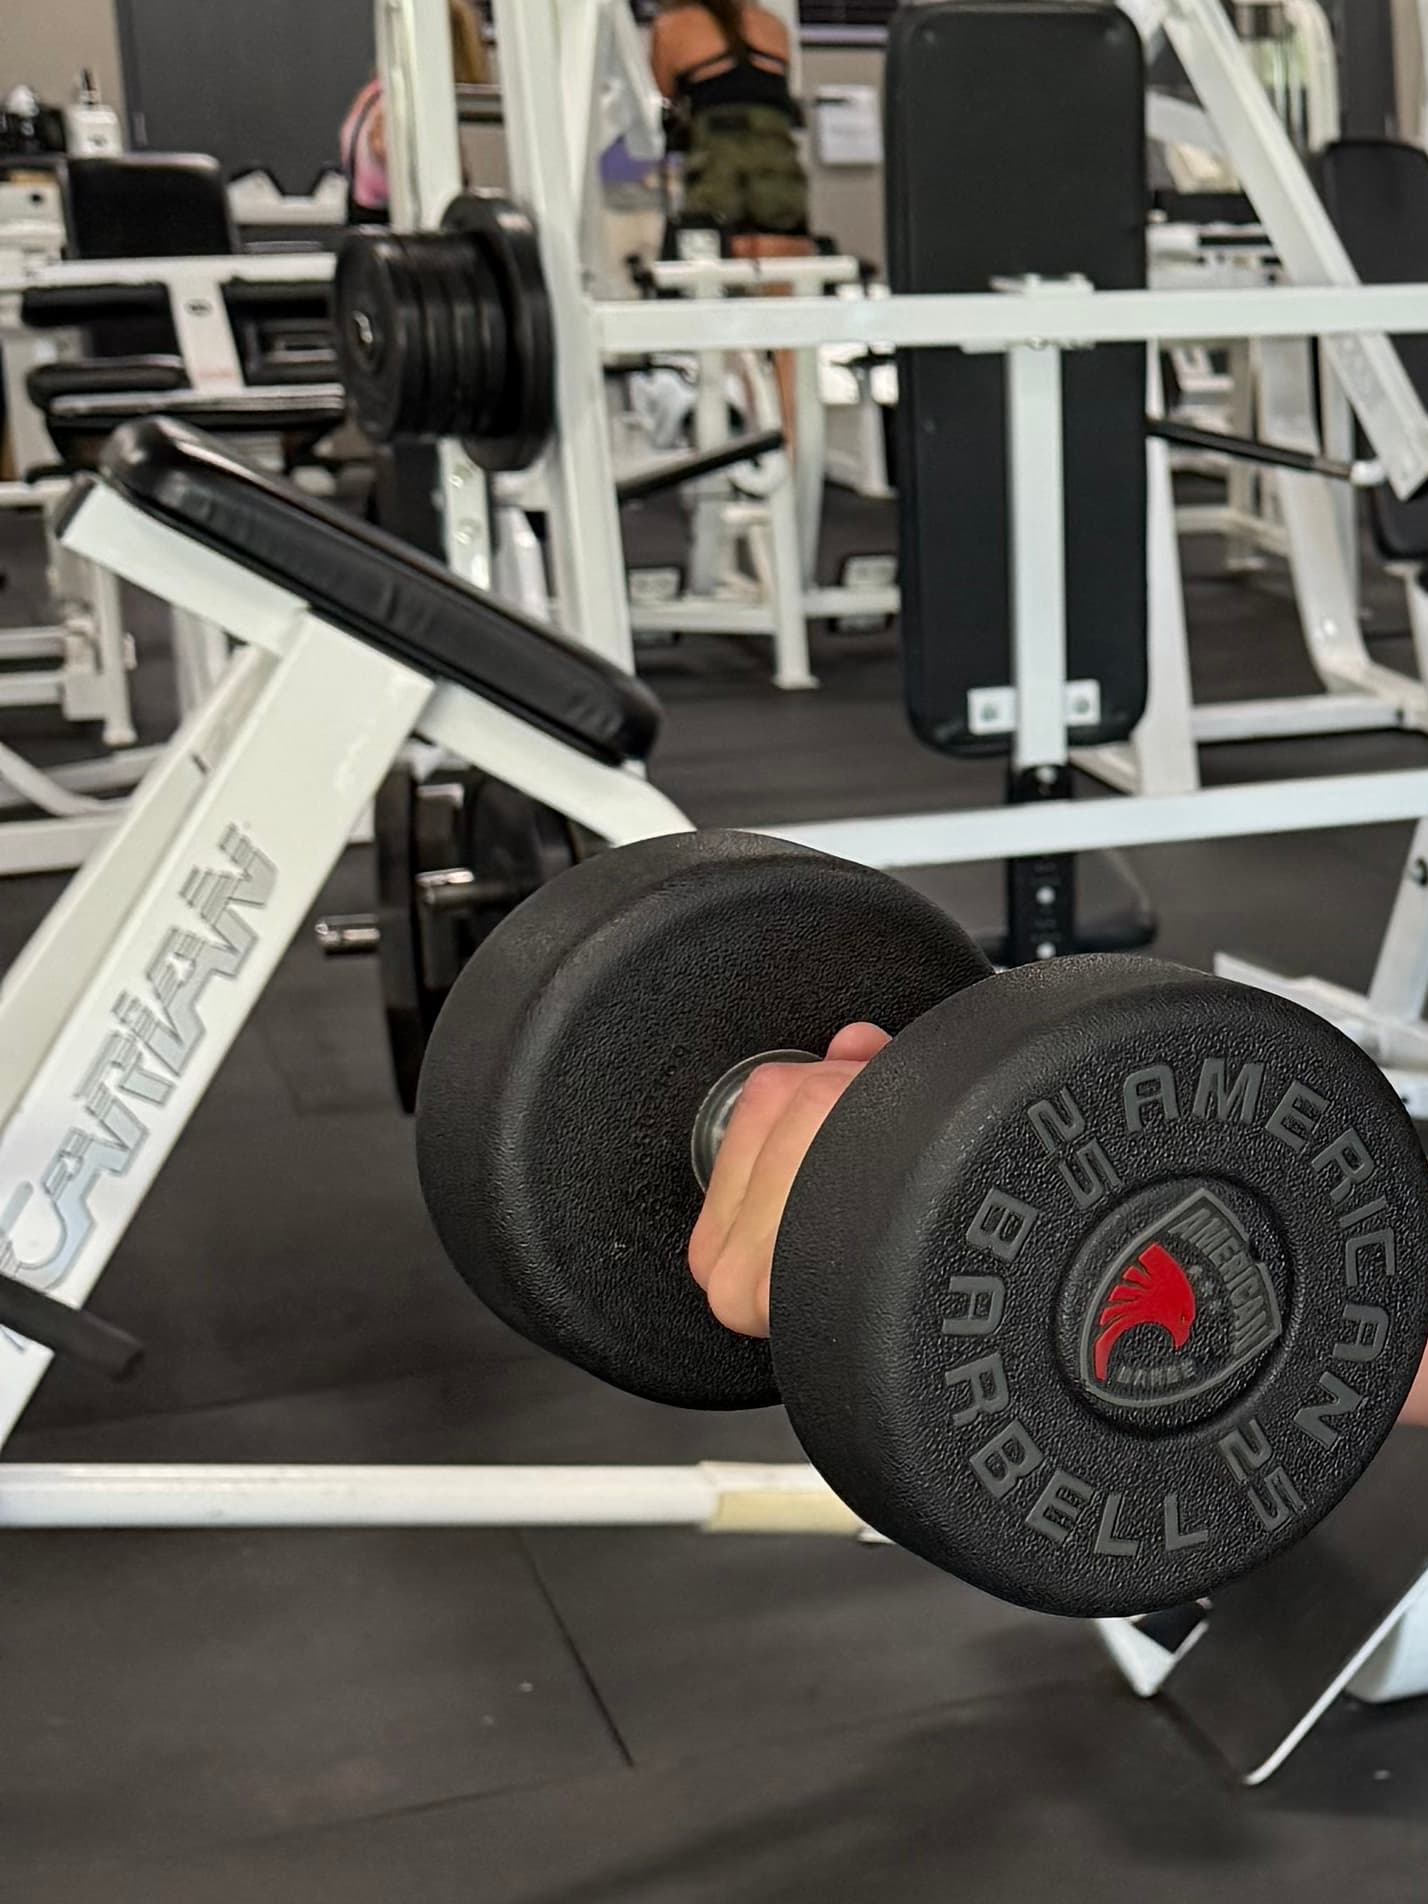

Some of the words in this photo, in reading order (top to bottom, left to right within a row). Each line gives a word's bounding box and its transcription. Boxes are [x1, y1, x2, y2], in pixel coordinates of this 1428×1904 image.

[1028, 1084, 1122, 1210] 25
[1123, 1059, 1396, 1451] AMERICAN
[1167, 1207, 1269, 1356] AMERICAN
[940, 1186, 1209, 1557] BARBELL
[1216, 1417, 1307, 1531] 25
